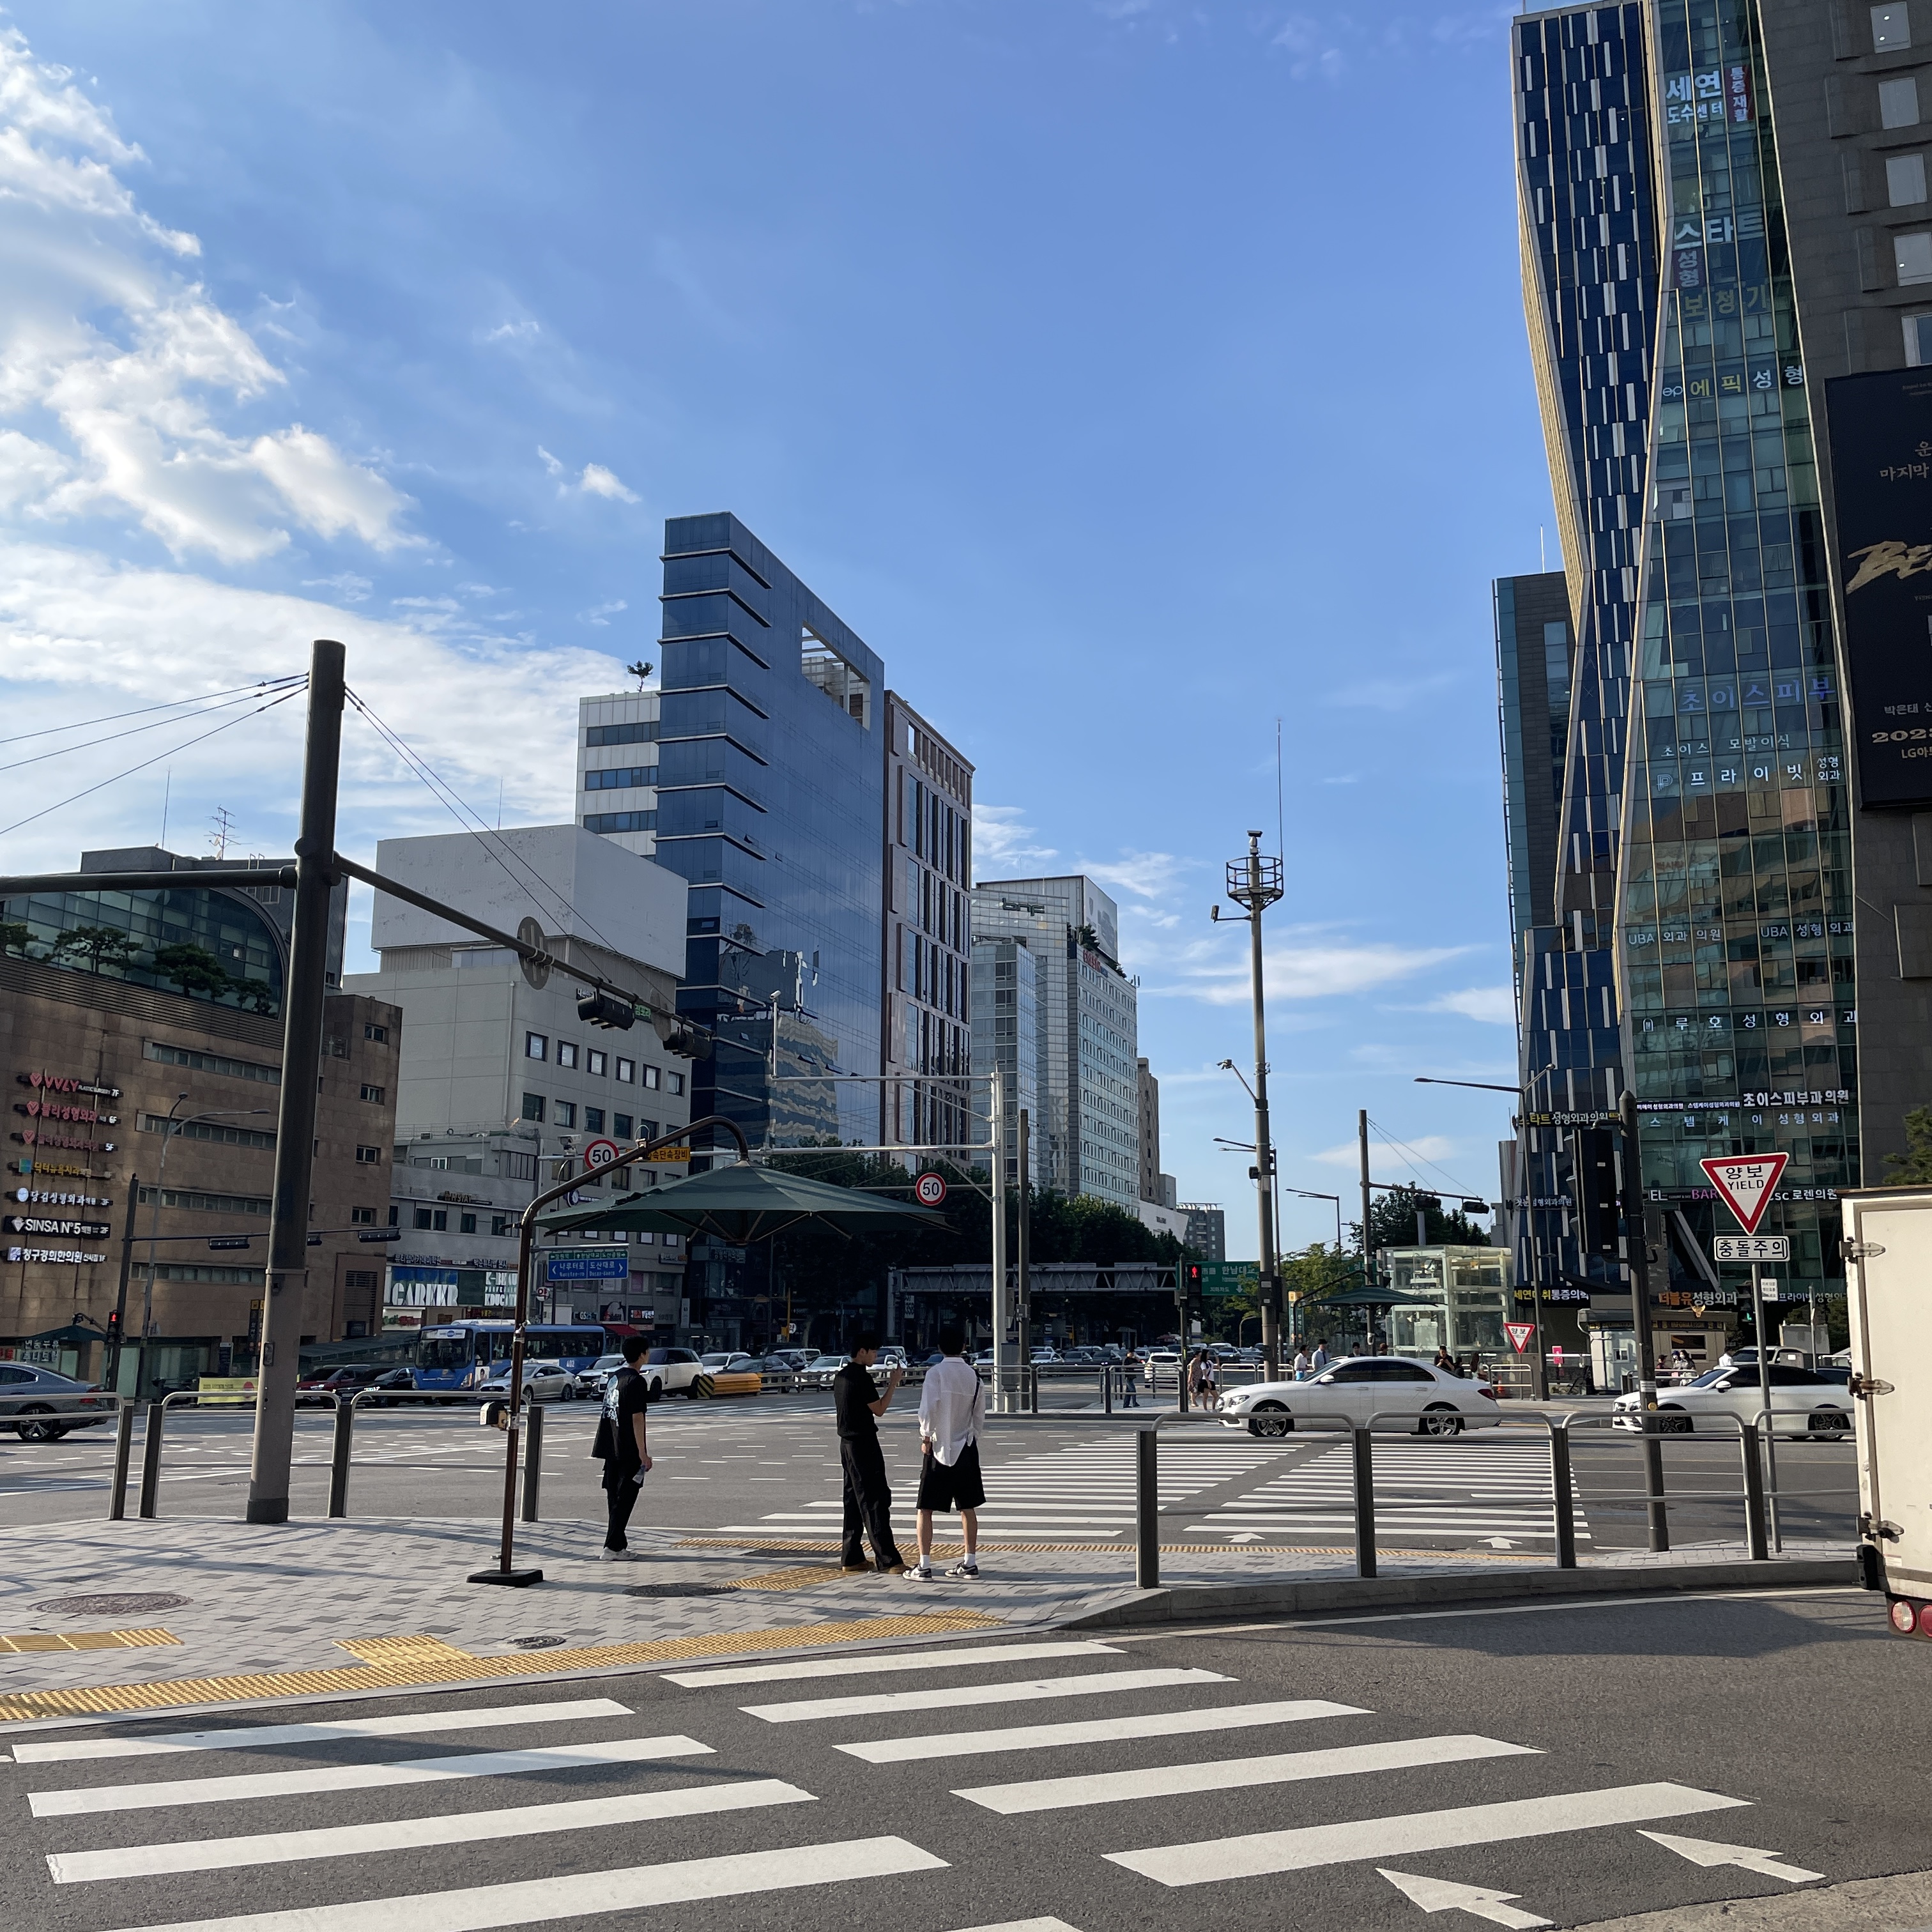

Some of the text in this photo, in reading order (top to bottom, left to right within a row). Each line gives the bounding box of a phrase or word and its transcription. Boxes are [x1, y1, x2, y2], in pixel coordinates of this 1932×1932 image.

[1666, 70, 1721, 101] 세연
[1667, 101, 1722, 124] 도수센터
[1675, 212, 1765, 249] 스타트
[1678, 250, 1699, 287] 성형
[1685, 285, 1767, 318] 보청기
[1880, 463, 1929, 482] 마지막
[1678, 676, 1836, 712] 초이스피부
[1884, 703, 1919, 715] 박은태
[1872, 728, 1932, 743] 202
[1661, 734, 1790, 757] 초이스 모발이식
[1817, 756, 1839, 769] 성형
[1690, 763, 1802, 786] 프라이빗
[1818, 770, 1840, 781] 외과
[1629, 928, 1721, 945] UBA 외과 의원
[1760, 921, 1854, 938] UBA 성형 외과
[1743, 1089, 1849, 1107] 초이스피부과의원
[1650, 1114, 1763, 1128] 스템케이
[592, 1149, 611, 1163] 50
[1726, 1165, 1763, 1180] 양보
[923, 1182, 939, 1196] 50
[1728, 1179, 1765, 1190] YIELD
[1691, 1189, 1721, 1200] BAR
[1792, 1188, 1838, 1200] 로렌의원
[25, 1218, 59, 1233] SINSA
[1719, 1240, 1785, 1258] 충돌주의
[589, 1261, 615, 1269] 도산대로
